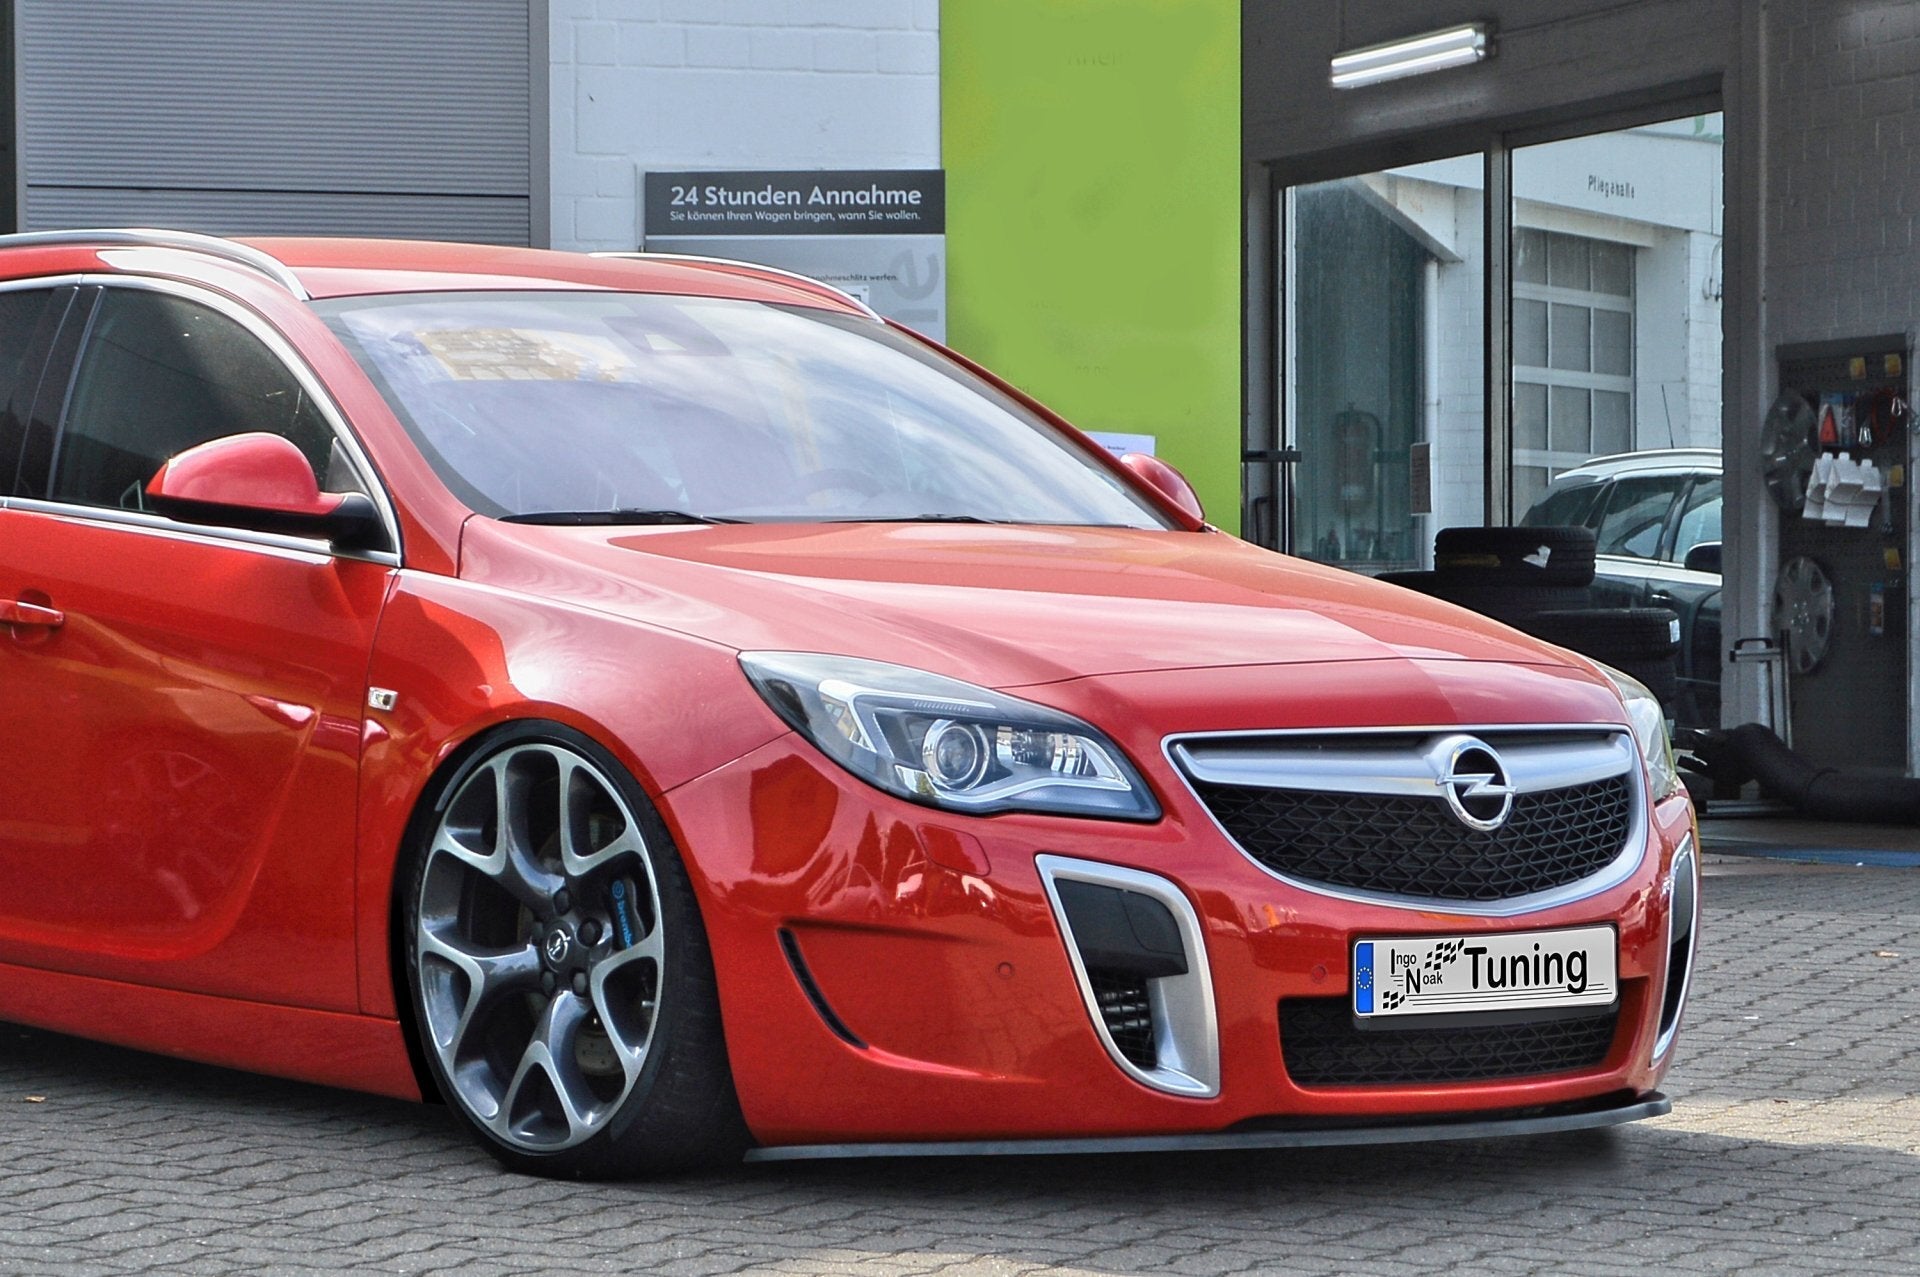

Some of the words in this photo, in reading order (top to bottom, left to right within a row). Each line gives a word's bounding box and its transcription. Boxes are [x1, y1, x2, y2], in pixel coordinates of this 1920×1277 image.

[671, 185, 699, 205] 24
[705, 184, 801, 205] Stunden
[807, 184, 922, 205] Annahme
[670, 211, 685, 221] Sie
[687, 210, 724, 221] können
[726, 210, 752, 221] Ihren
[755, 211, 791, 223] Wagen
[793, 210, 836, 223] bringen,
[838, 212, 866, 221] wann
[868, 210, 884, 221] Sie
[886, 210, 921, 221] wollen.
[1390, 948, 1417, 974] Ingo
[1464, 943, 1587, 994] Tuning
[1406, 968, 1443, 994] Noak
